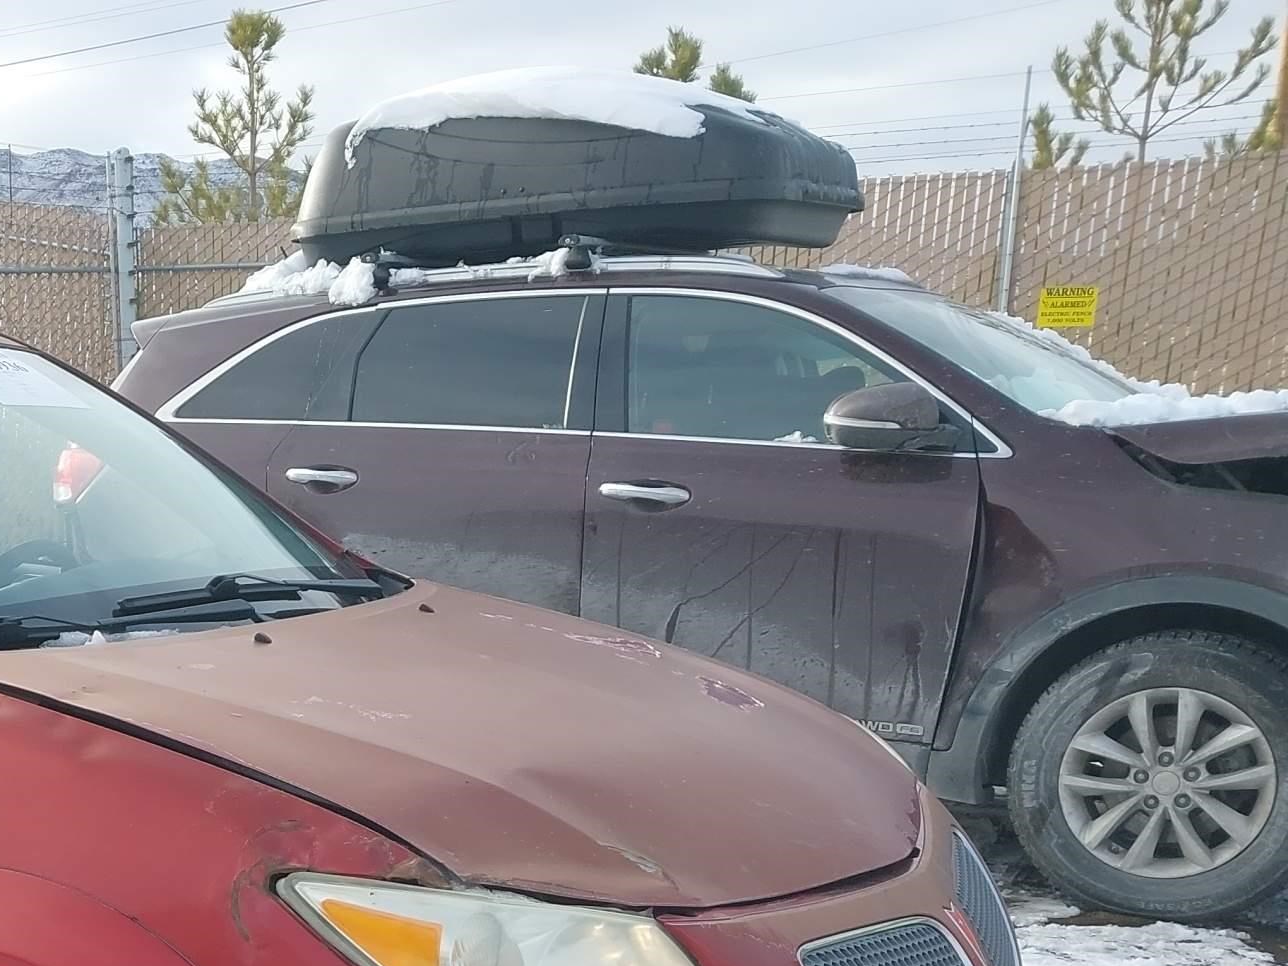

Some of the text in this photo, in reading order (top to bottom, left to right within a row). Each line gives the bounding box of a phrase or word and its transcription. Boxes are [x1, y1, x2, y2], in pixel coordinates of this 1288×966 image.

[1046, 287, 1095, 297] WARNING
[1049, 300, 1087, 308] ALARMED
[856, 719, 893, 732] WD
